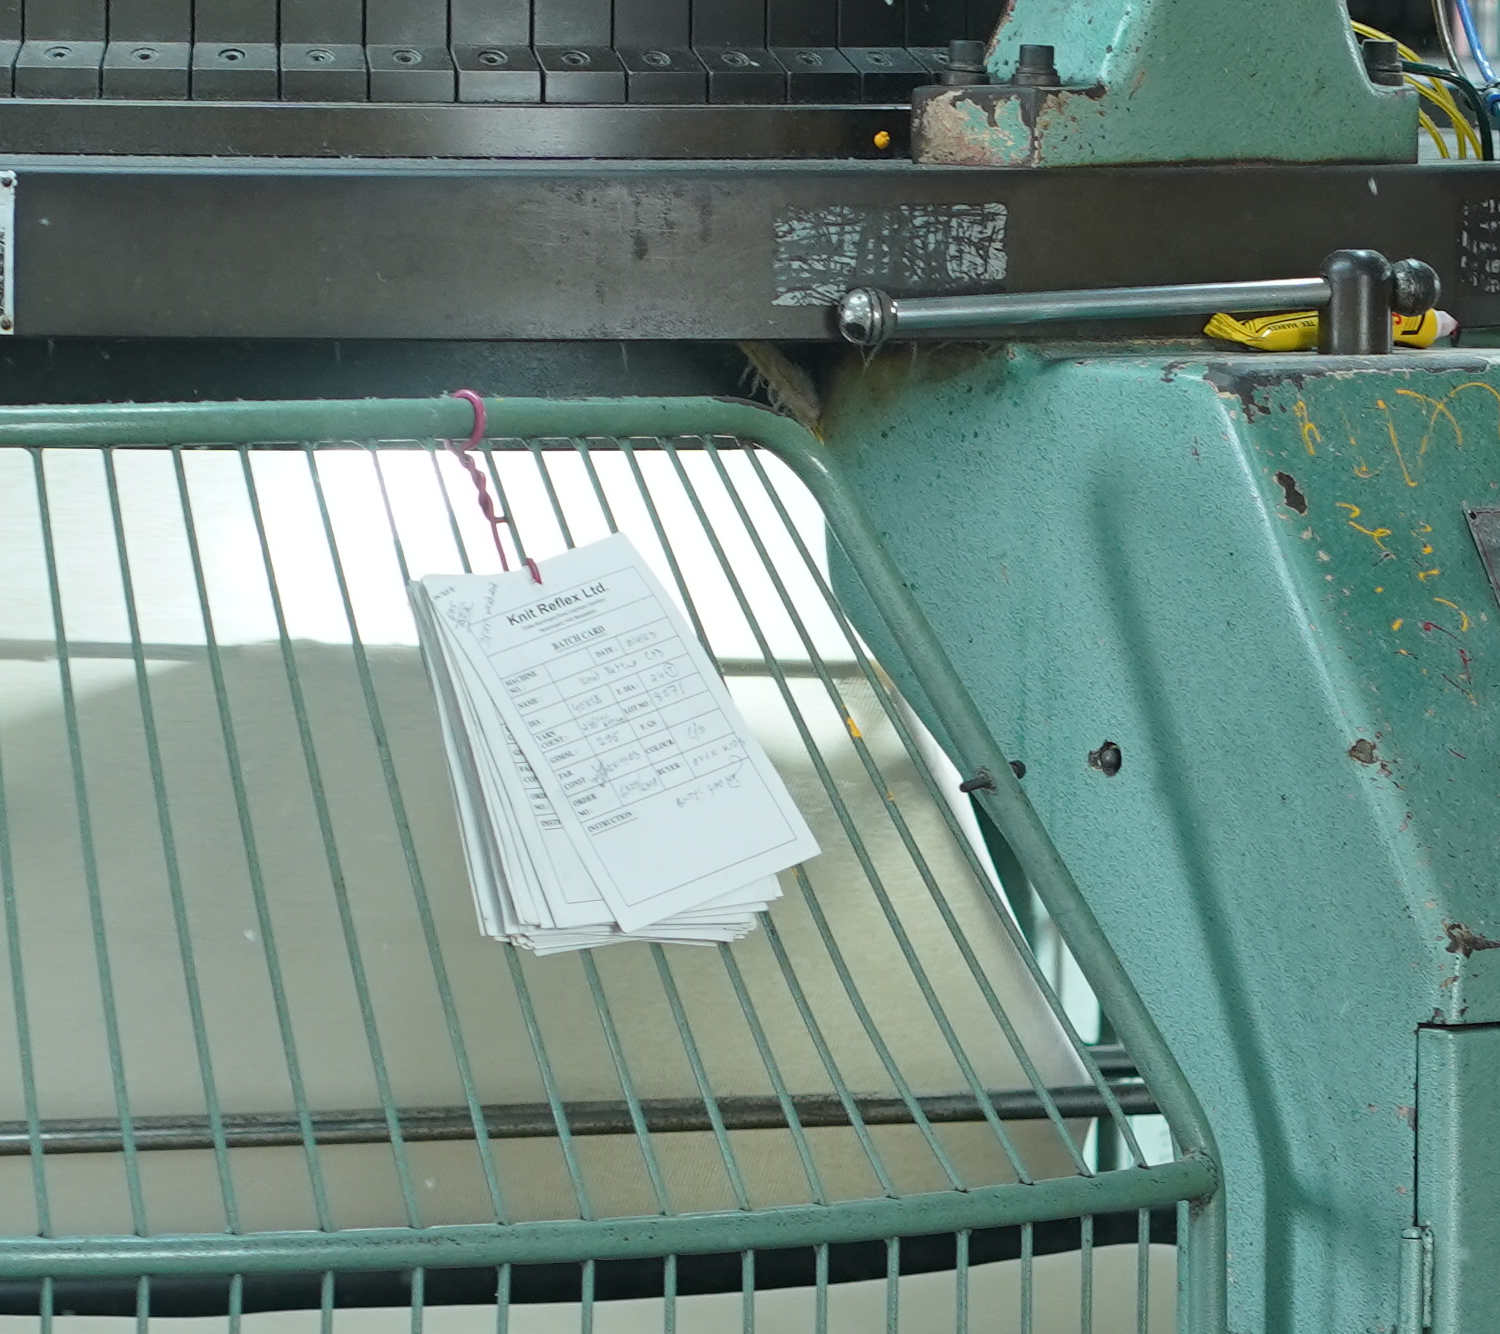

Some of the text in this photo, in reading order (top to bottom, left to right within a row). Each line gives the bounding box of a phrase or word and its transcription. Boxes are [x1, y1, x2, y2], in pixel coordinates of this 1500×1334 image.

[506, 609, 537, 625] Knit
[536, 593, 581, 615] Reflex
[580, 582, 610, 598] Ltd.
[551, 626, 606, 651] BATCH CARD
